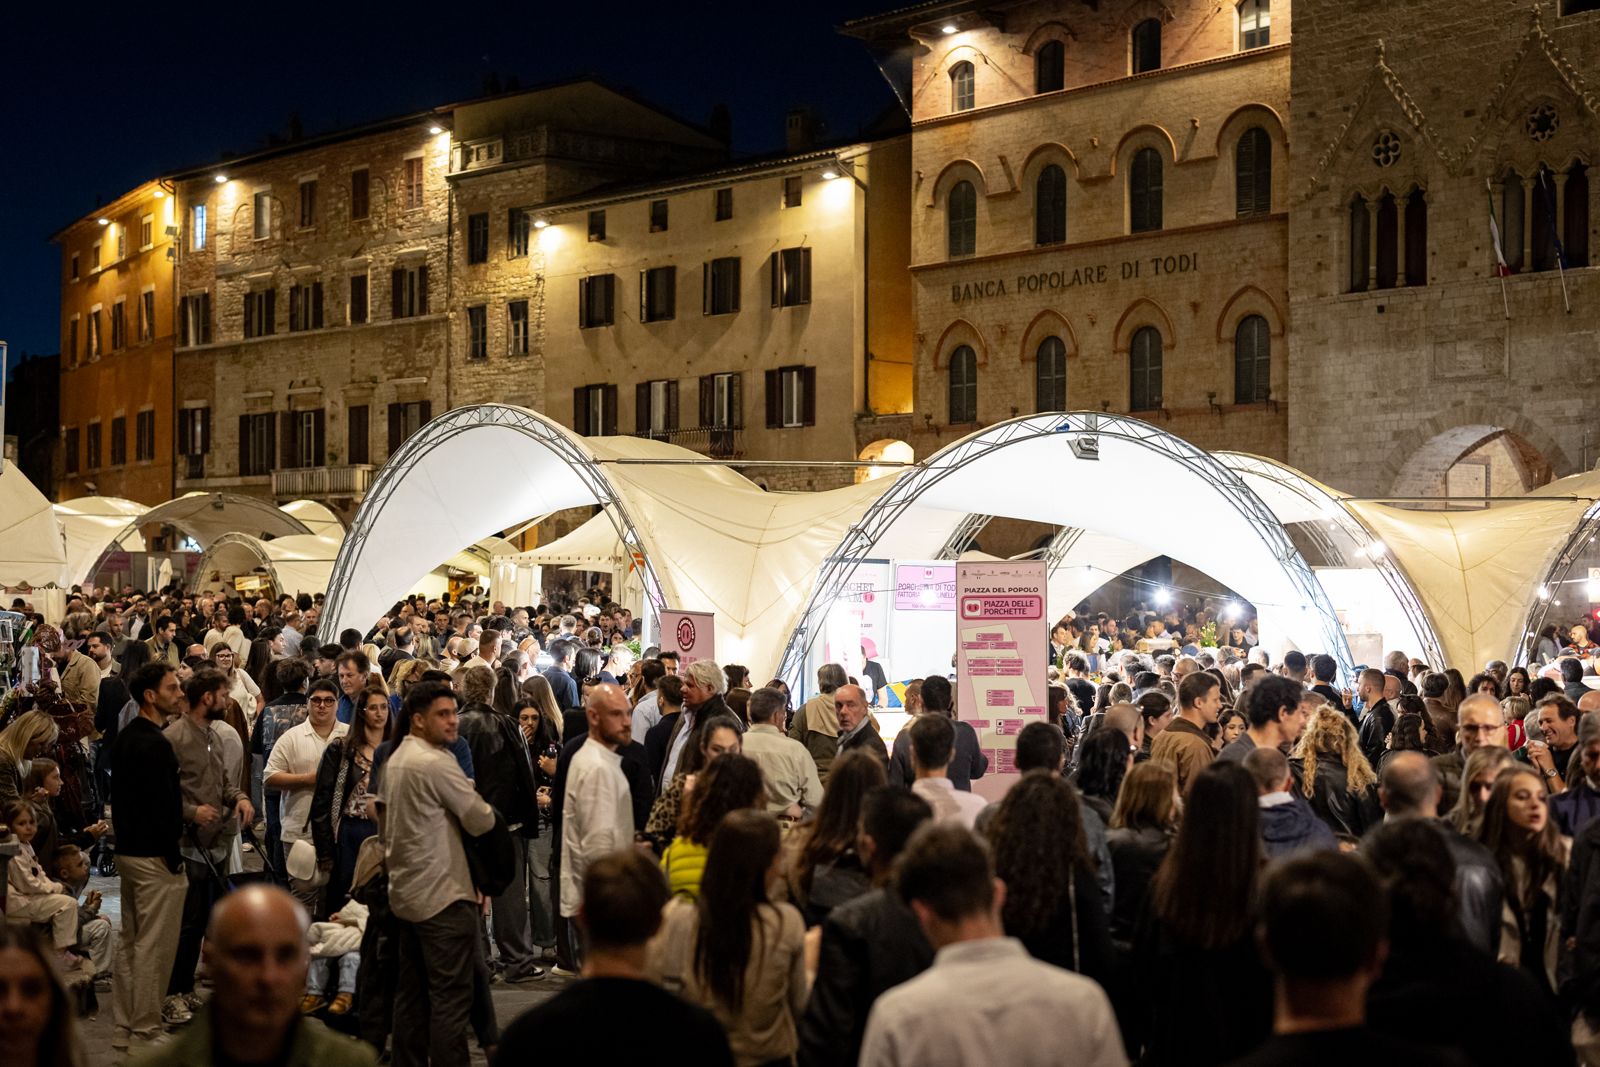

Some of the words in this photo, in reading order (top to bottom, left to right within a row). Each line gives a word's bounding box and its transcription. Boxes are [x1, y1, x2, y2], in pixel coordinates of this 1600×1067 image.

[952, 279, 1007, 304] BANCA
[1017, 265, 1108, 294] POPOLARE
[1121, 260, 1140, 280] DI
[1151, 252, 1198, 276] TODI
[837, 583, 874, 592] RCHET
[943, 584, 956, 592] TOD
[984, 607, 1027, 615] PORCHETTE
